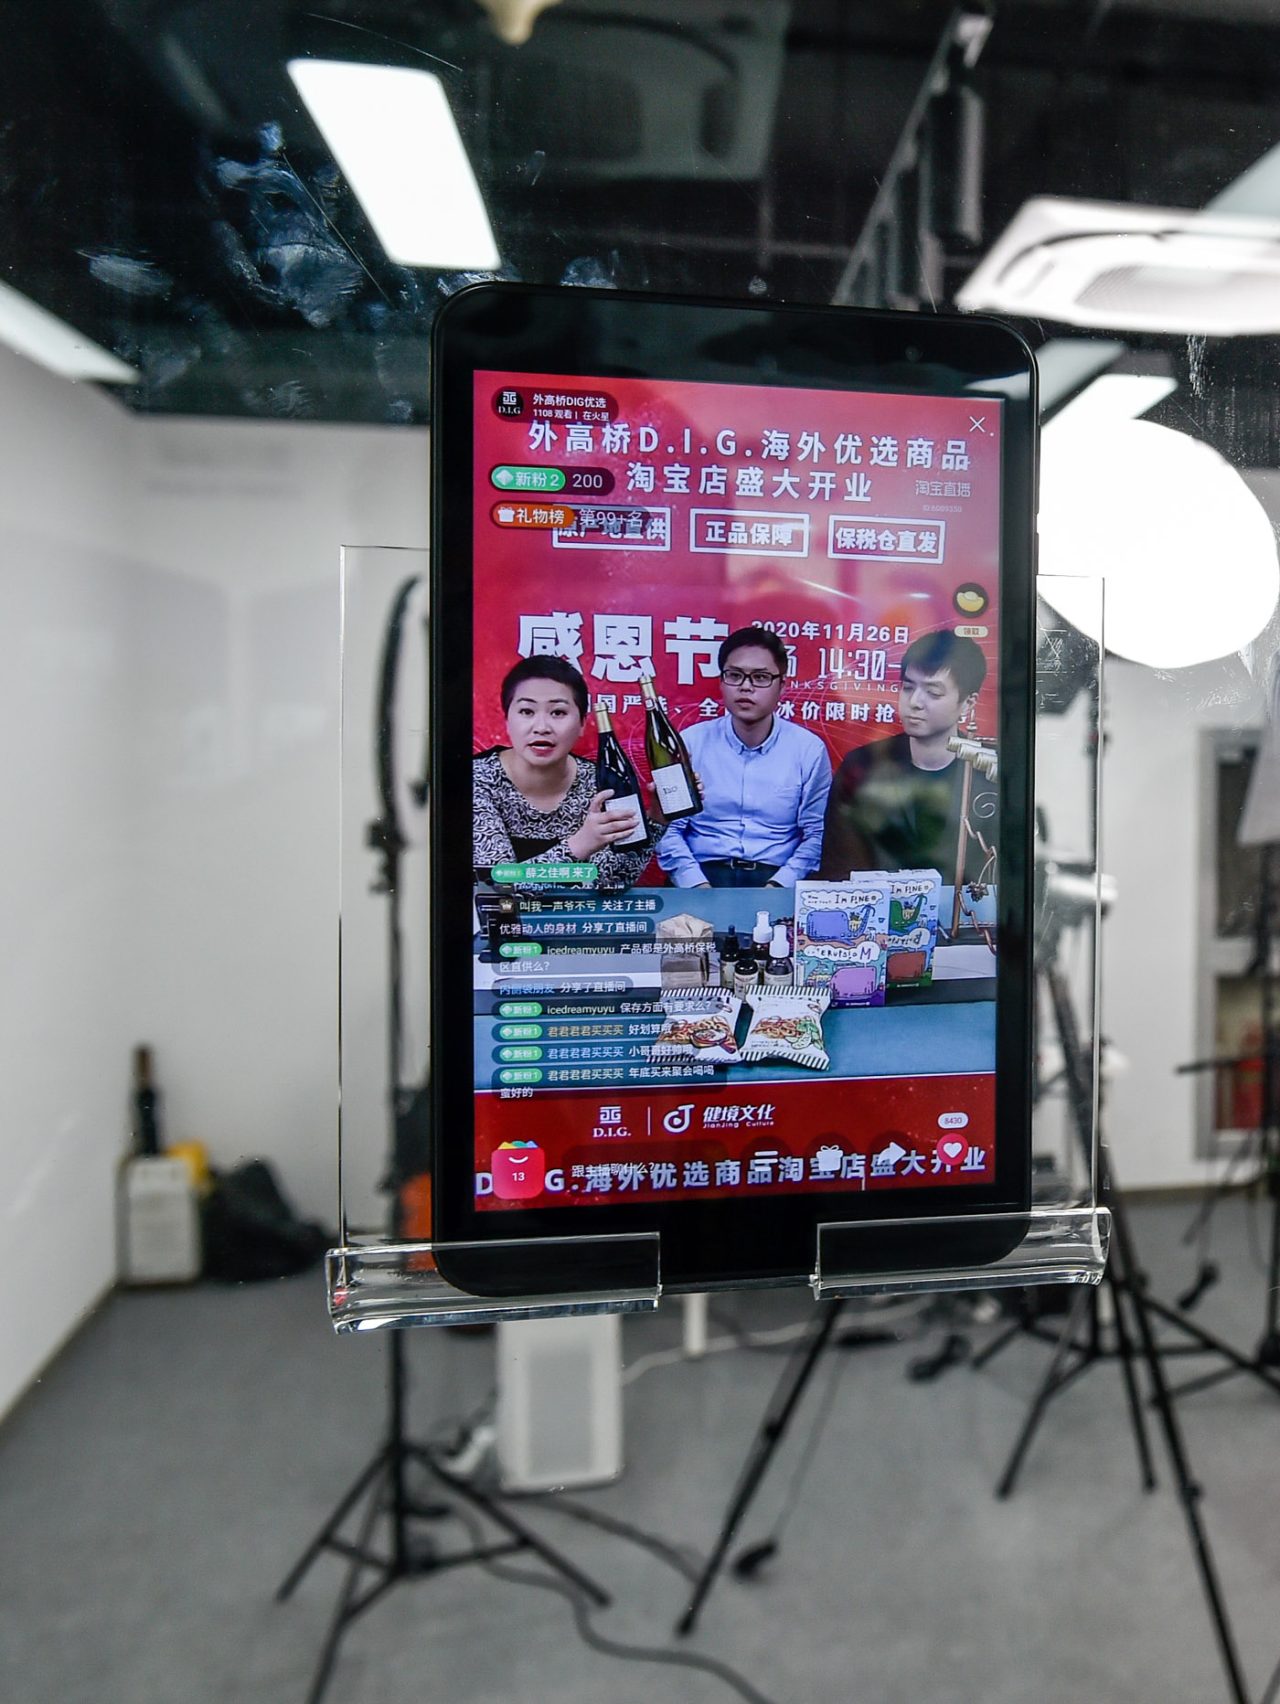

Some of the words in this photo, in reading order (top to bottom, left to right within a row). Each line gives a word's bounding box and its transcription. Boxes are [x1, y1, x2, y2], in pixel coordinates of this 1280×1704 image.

[533, 393, 607, 409] 外高桥DIG优选
[528, 420, 971, 471] 外高桥D.I.G.海外优选商品
[515, 471, 547, 487] 新粉
[572, 473, 603, 488] 200
[626, 462, 872, 502] 淘宝店盛大开业
[914, 479, 971, 498] 淘宝直播
[517, 507, 565, 525] 礼物榜
[705, 520, 793, 546] 正品保障
[835, 527, 937, 553] 保税仓直发
[517, 611, 729, 686] 感恩节
[790, 680, 899, 693] NKSGIVING
[602, 900, 656, 912] 关注了主播
[500, 923, 577, 935] 优雅动人的身材
[582, 922, 648, 934] 分享了直播间
[620, 941, 717, 955] 产品都是外高桥保税
[560, 981, 626, 993] 分享了直播间
[547, 1004, 616, 1016] icedreamyuyu
[547, 1024, 624, 1038] 君君君君买买买
[547, 1046, 624, 1059] 君君君君买买买
[547, 1068, 624, 1081] 君君君君买买买
[592, 1127, 632, 1138] D.I.G.
[512, 1172, 525, 1182] 13
